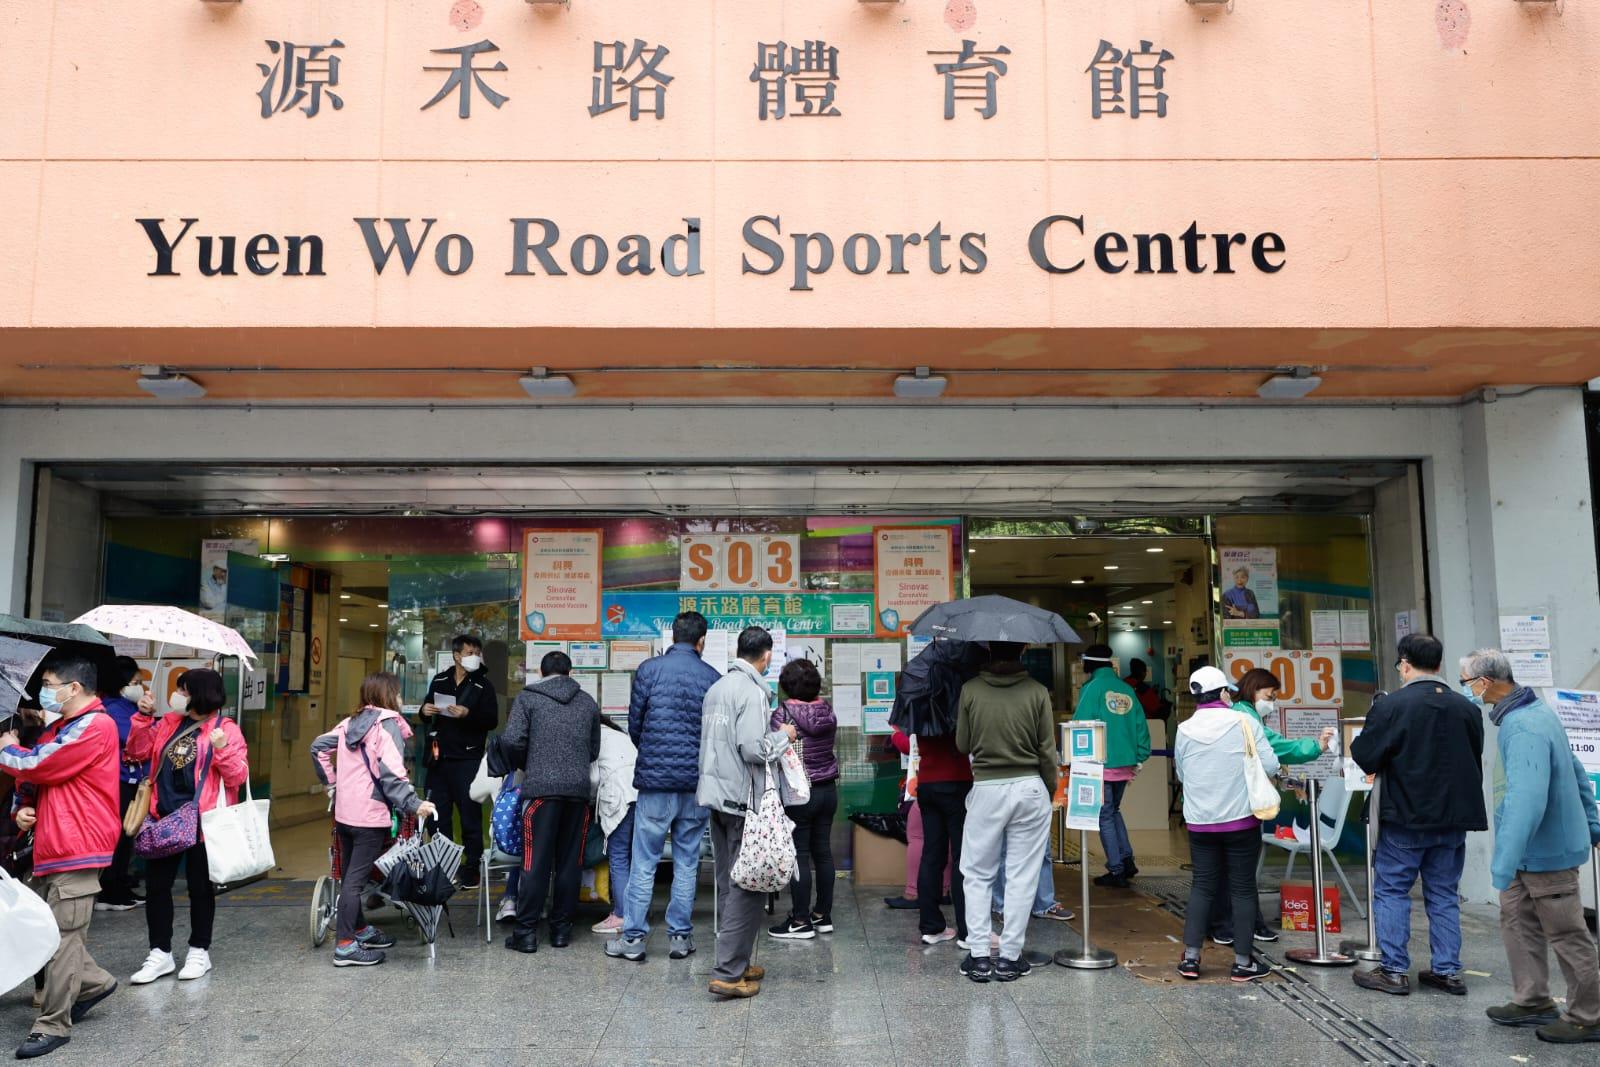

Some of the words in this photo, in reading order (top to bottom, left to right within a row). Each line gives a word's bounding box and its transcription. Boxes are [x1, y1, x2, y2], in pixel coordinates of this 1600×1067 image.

[257, 39, 1174, 121] 源禾路體育館
[135, 218, 326, 276] Yuen
[354, 218, 473, 276] Wo
[505, 218, 704, 277] Road
[743, 216, 987, 292] Sports
[1029, 215, 1286, 275] Centre
[688, 541, 793, 585] S03
[546, 585, 577, 594] Sinovac
[898, 582, 929, 591] Sinovac
[679, 596, 802, 615] 源禾路體育館
[711, 617, 746, 631] Road
[786, 617, 823, 631] Centre
[243, 676, 265, 699] 出口
